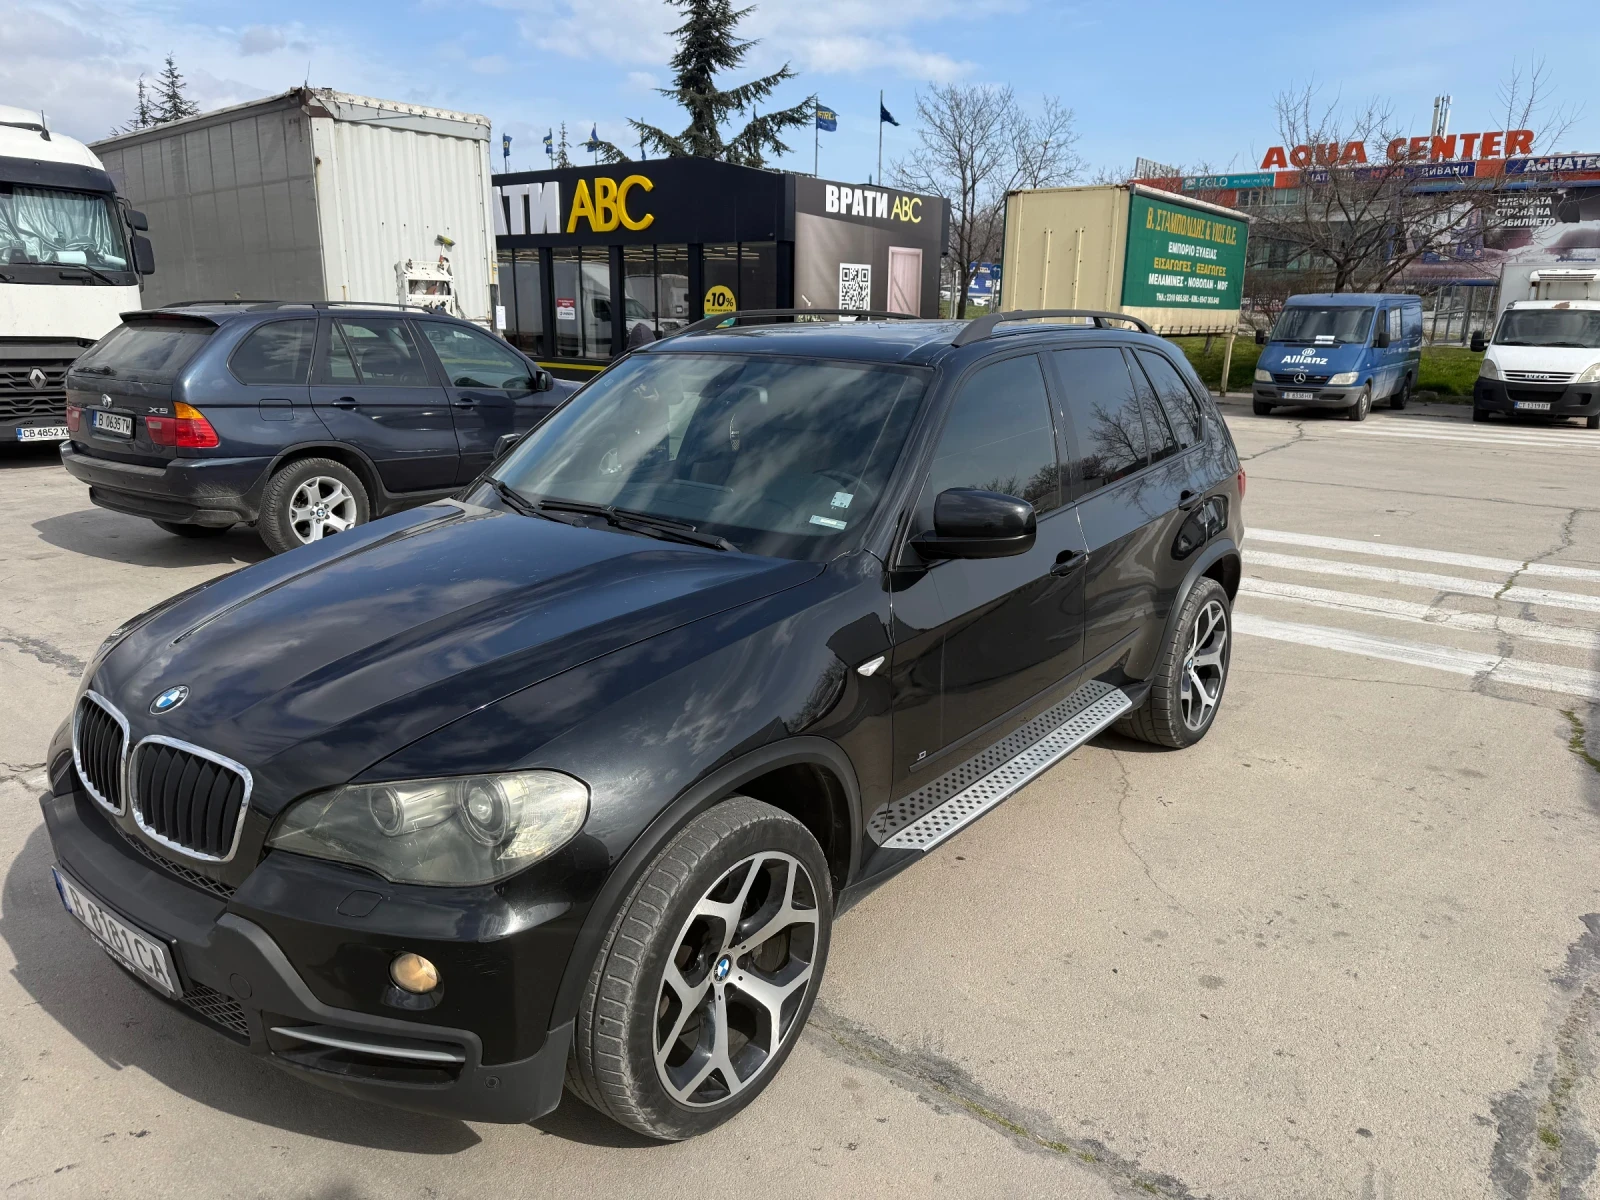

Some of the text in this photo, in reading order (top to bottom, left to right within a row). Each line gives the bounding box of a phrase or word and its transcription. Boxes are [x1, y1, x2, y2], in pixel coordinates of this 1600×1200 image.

[1260, 130, 1534, 169] AQUA CENTER
[1421, 165, 1469, 178] ДИВАНИ
[1199, 177, 1228, 188] EGLO
[825, 184, 888, 219] ВРАТИ
[1536, 207, 1551, 216] НА
[1168, 241, 1195, 256] ΕΜΠΟΡΙΟ
[1154, 257, 1226, 276] ΕΙΣΑΓΩΓΕΣ ΕΞΑΓΩΓΕΣ
[1148, 273, 1184, 287] ΜΕΛΑΜΙΝΕΣ
[706, 292, 734, 307] -10%
[1281, 355, 1328, 365] Allianz
[99, 413, 104, 426] B
[106, 415, 121, 431] 0635
[23, 430, 35, 438] CB
[37, 428, 59, 437] 4852
[68, 886, 169, 985] B 8181 CA
